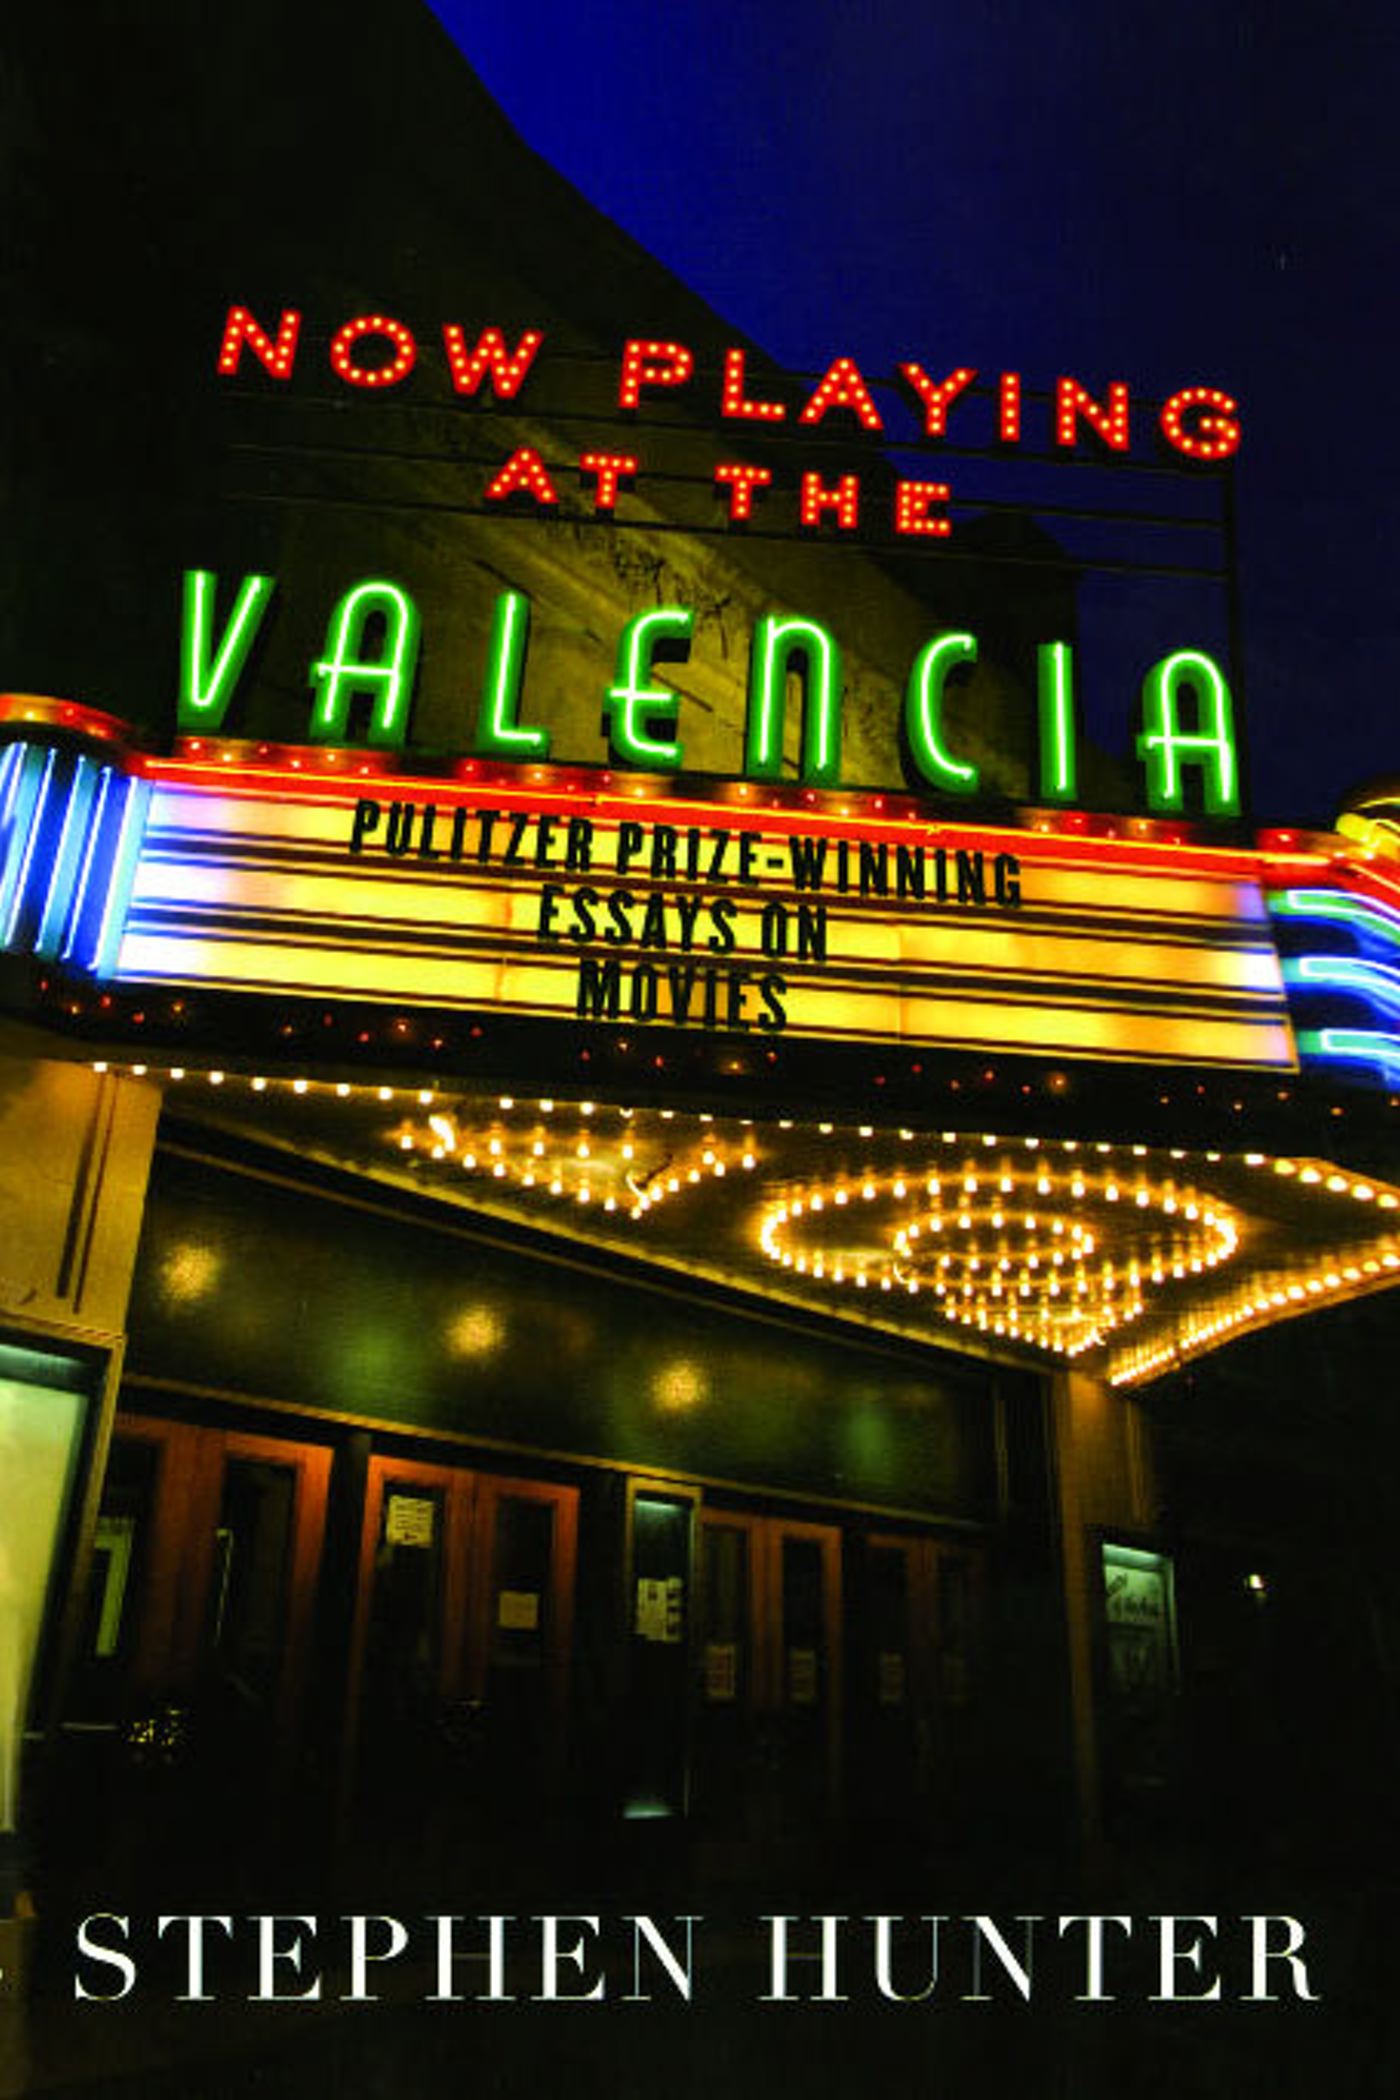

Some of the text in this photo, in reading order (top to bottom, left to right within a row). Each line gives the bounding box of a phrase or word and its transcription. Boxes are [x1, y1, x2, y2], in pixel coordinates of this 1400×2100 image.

[217, 305, 1242, 461] NOW PLAYING
[485, 447, 952, 538] AT THE
[176, 569, 1242, 818] VALENCIA
[350, 798, 1021, 908] PULITZER PRIZE-WINNING
[537, 883, 827, 963] ESSAYS ON
[576, 956, 788, 1033] MOVIES
